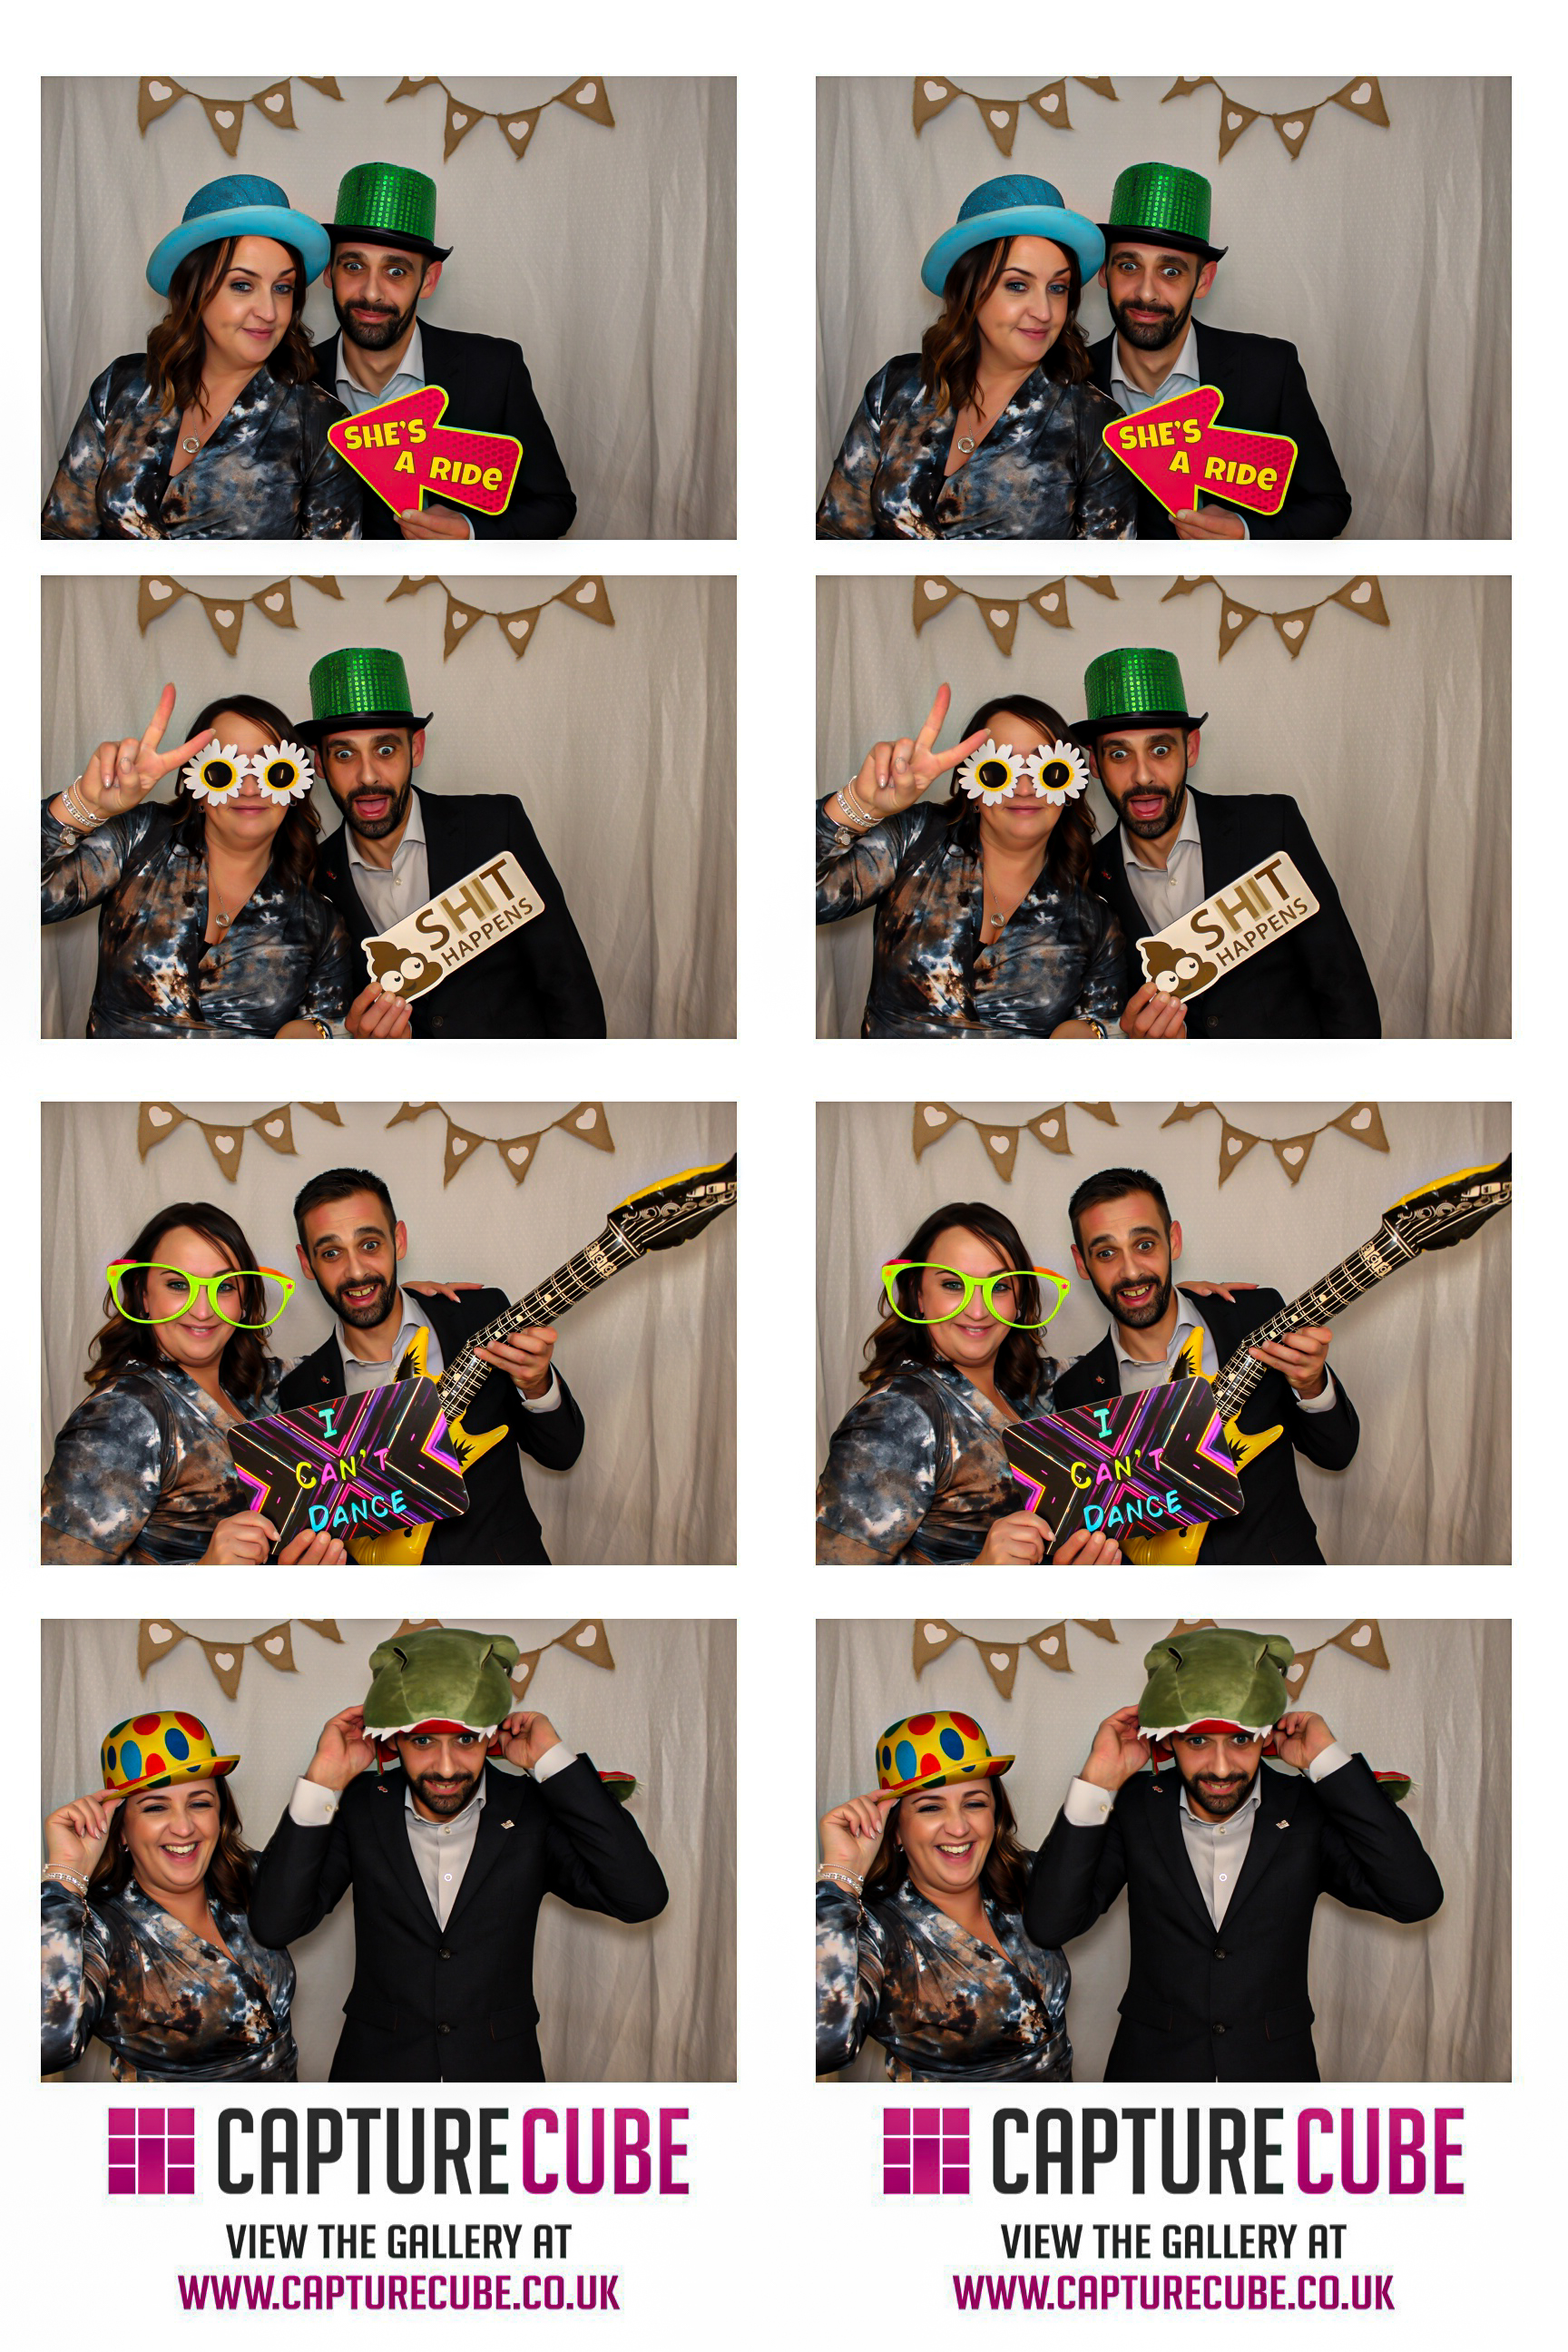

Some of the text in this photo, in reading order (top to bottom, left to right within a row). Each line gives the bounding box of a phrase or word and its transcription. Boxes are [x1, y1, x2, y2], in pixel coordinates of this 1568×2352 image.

[344, 418, 427, 450] SHE'S
[1119, 418, 1202, 450] SHE'S
[394, 450, 416, 475] A
[1169, 450, 1191, 475] A
[416, 858, 514, 951] SHIT
[1191, 858, 1289, 951] SHIT
[441, 897, 534, 966] HAPPENS
[1216, 897, 1308, 966] HAPPENS
[318, 1407, 338, 1439] I
[1093, 1407, 1112, 1439] I
[295, 1447, 389, 1489] CAN'T
[1070, 1447, 1164, 1489] CAN'T
[309, 1489, 407, 1533] DANCE
[1083, 1489, 1182, 1533] DANCE
